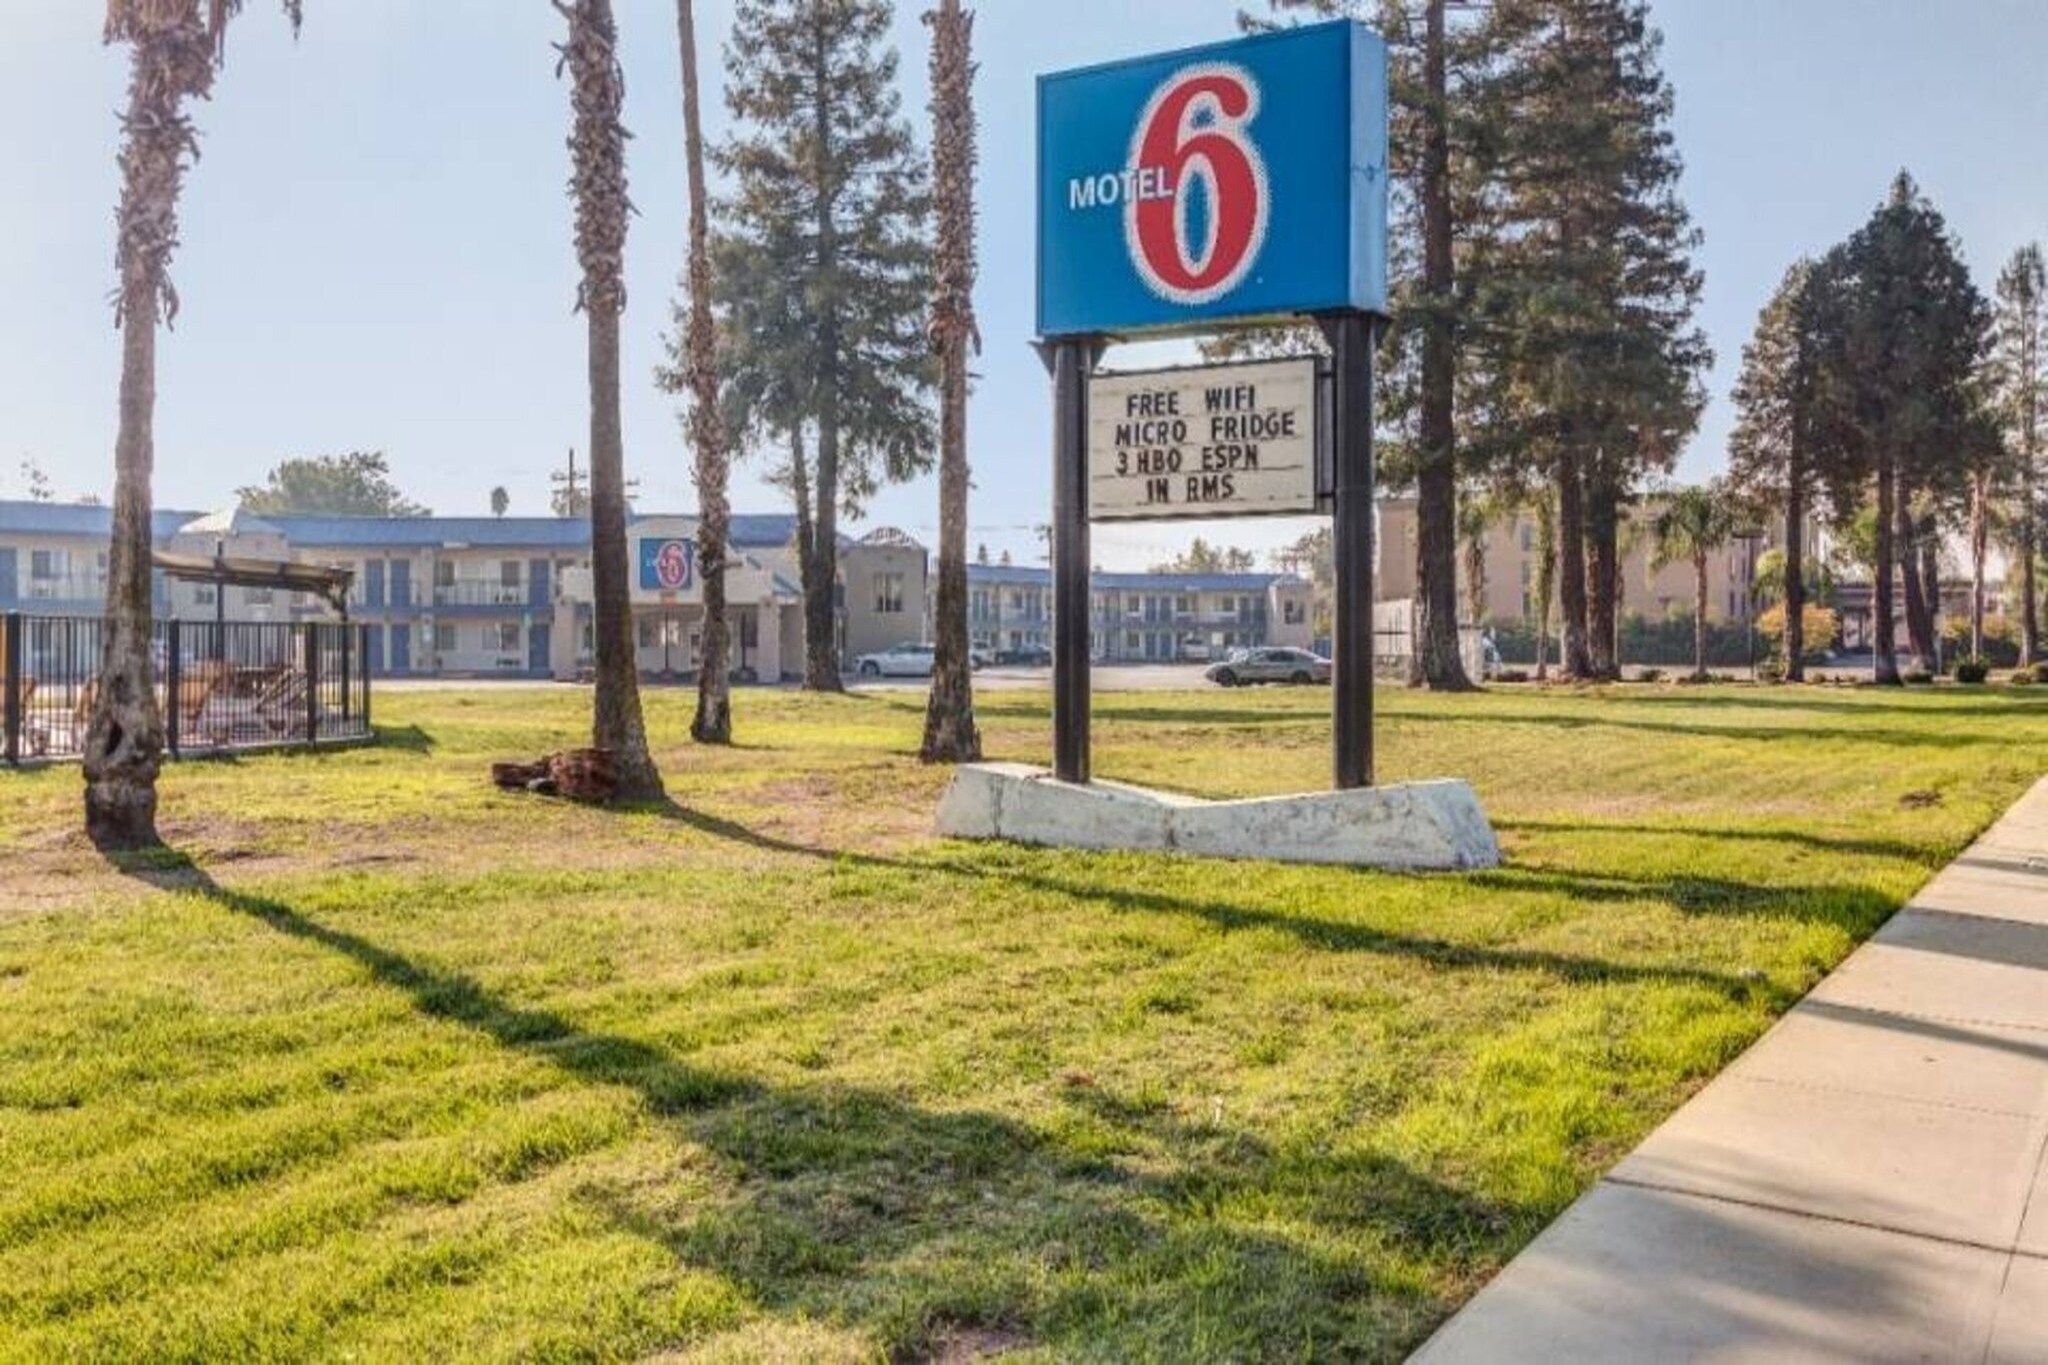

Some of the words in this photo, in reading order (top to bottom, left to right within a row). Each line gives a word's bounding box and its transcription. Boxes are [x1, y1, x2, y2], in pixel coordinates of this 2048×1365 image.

[1069, 167, 1174, 210] MOTEL
[1126, 63, 1268, 303] 6
[1126, 391, 1179, 417] FREE
[1206, 385, 1255, 411] WIFI
[1114, 420, 1187, 446] MICRO
[1211, 412, 1295, 439] FRIDGE
[1115, 452, 1128, 475] 3
[1136, 450, 1182, 475] HBO
[1202, 444, 1258, 471] ESPN
[1146, 478, 1168, 504] IN
[1186, 475, 1235, 501] RMS
